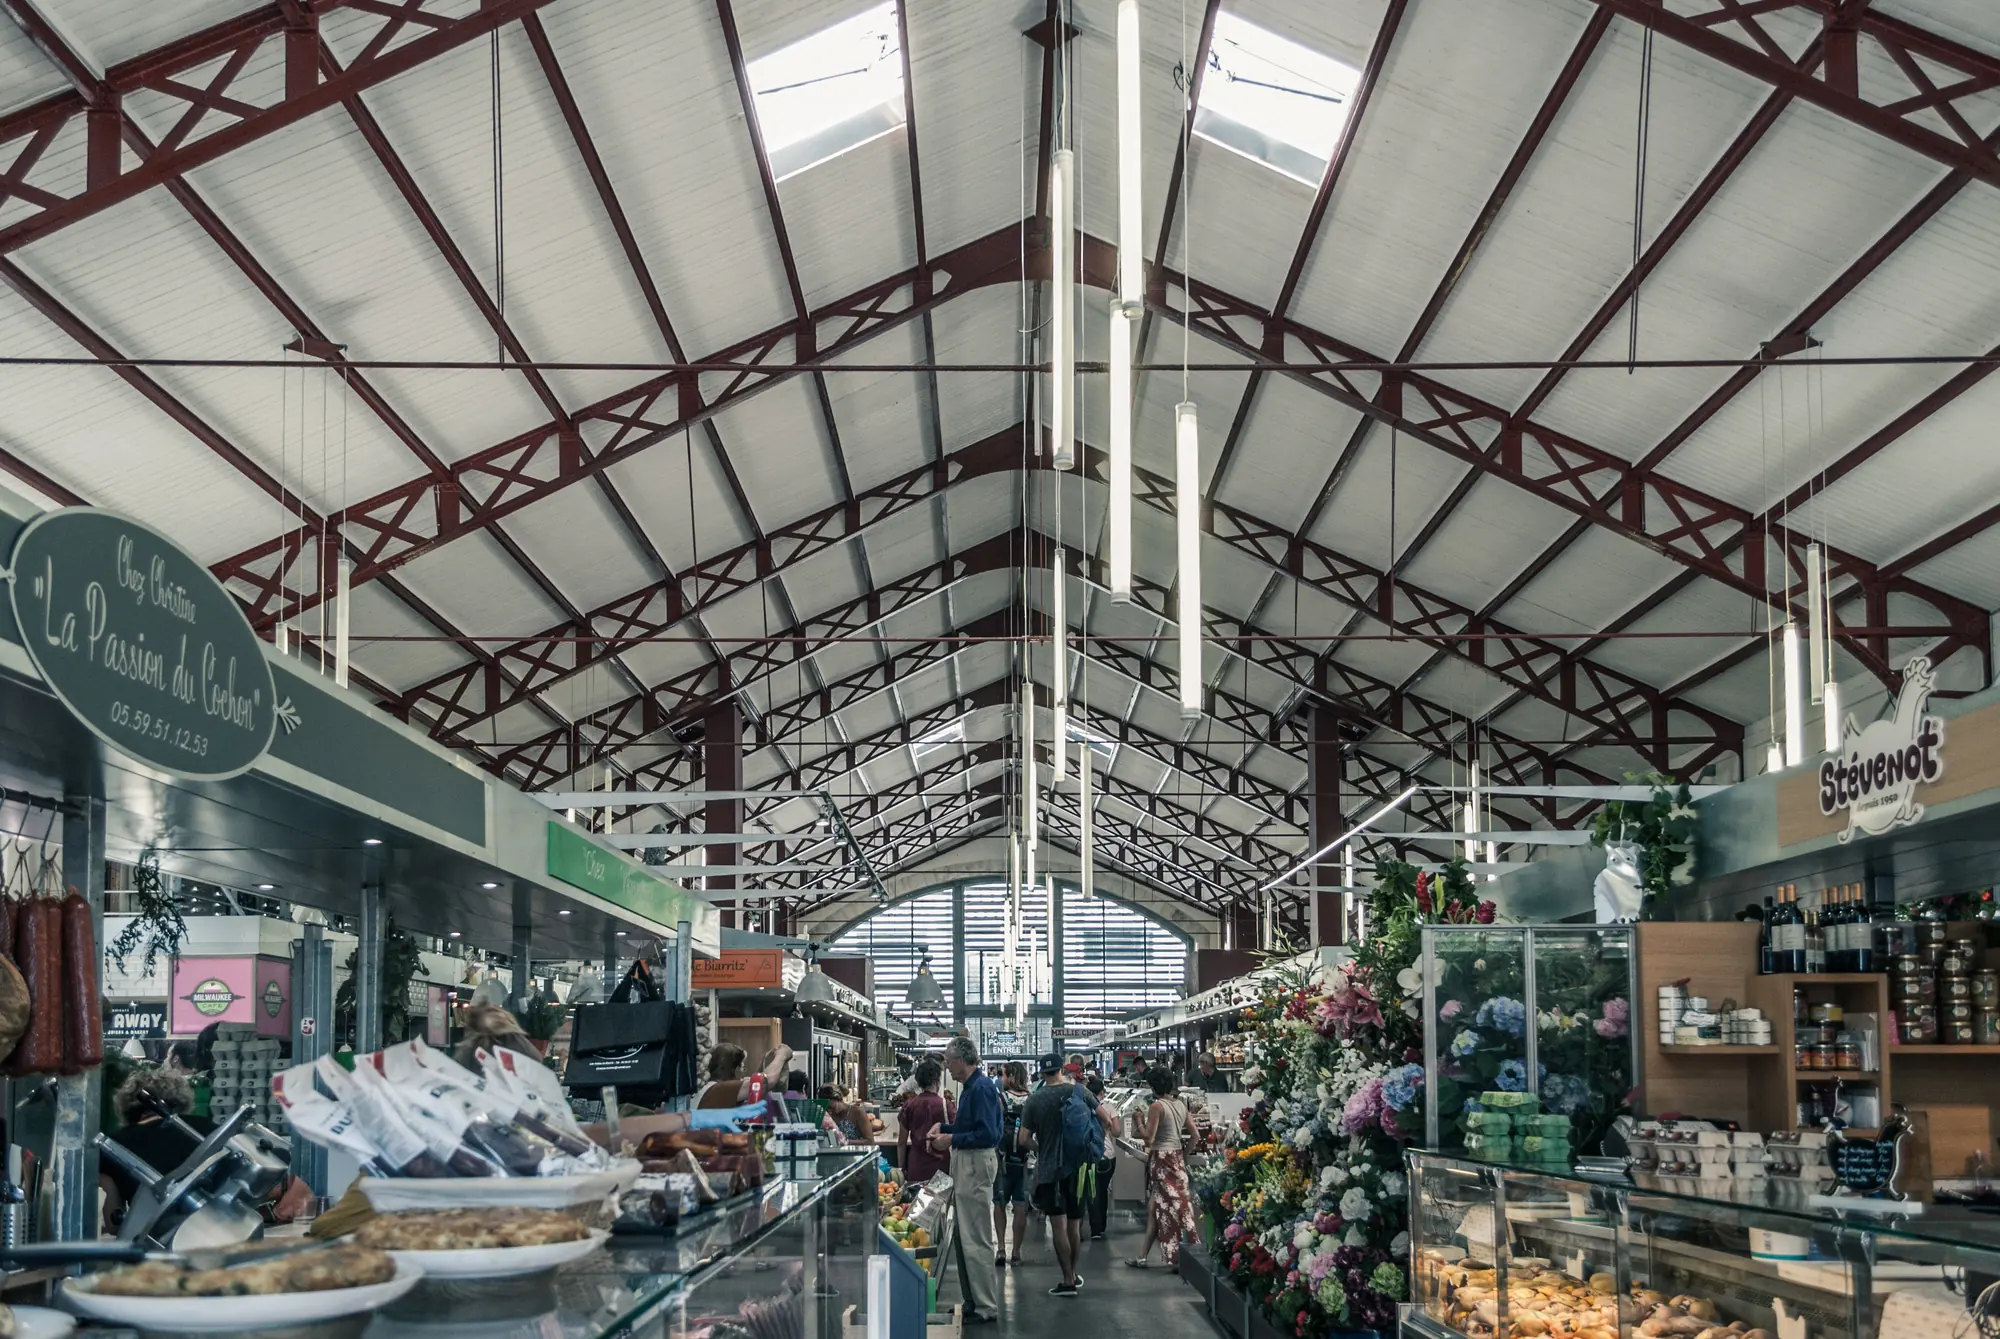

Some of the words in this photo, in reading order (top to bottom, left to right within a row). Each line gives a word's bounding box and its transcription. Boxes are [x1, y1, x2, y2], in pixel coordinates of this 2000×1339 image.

[118, 534, 146, 605] Chez
[151, 554, 197, 625] Christine
[86, 581, 166, 692] Passion
[172, 633, 196, 704] du
[111, 700, 209, 757] 05.59.51.12.53
[114, 1013, 162, 1028] AWAY
[193, 993, 232, 1001] MILWAUKEE
